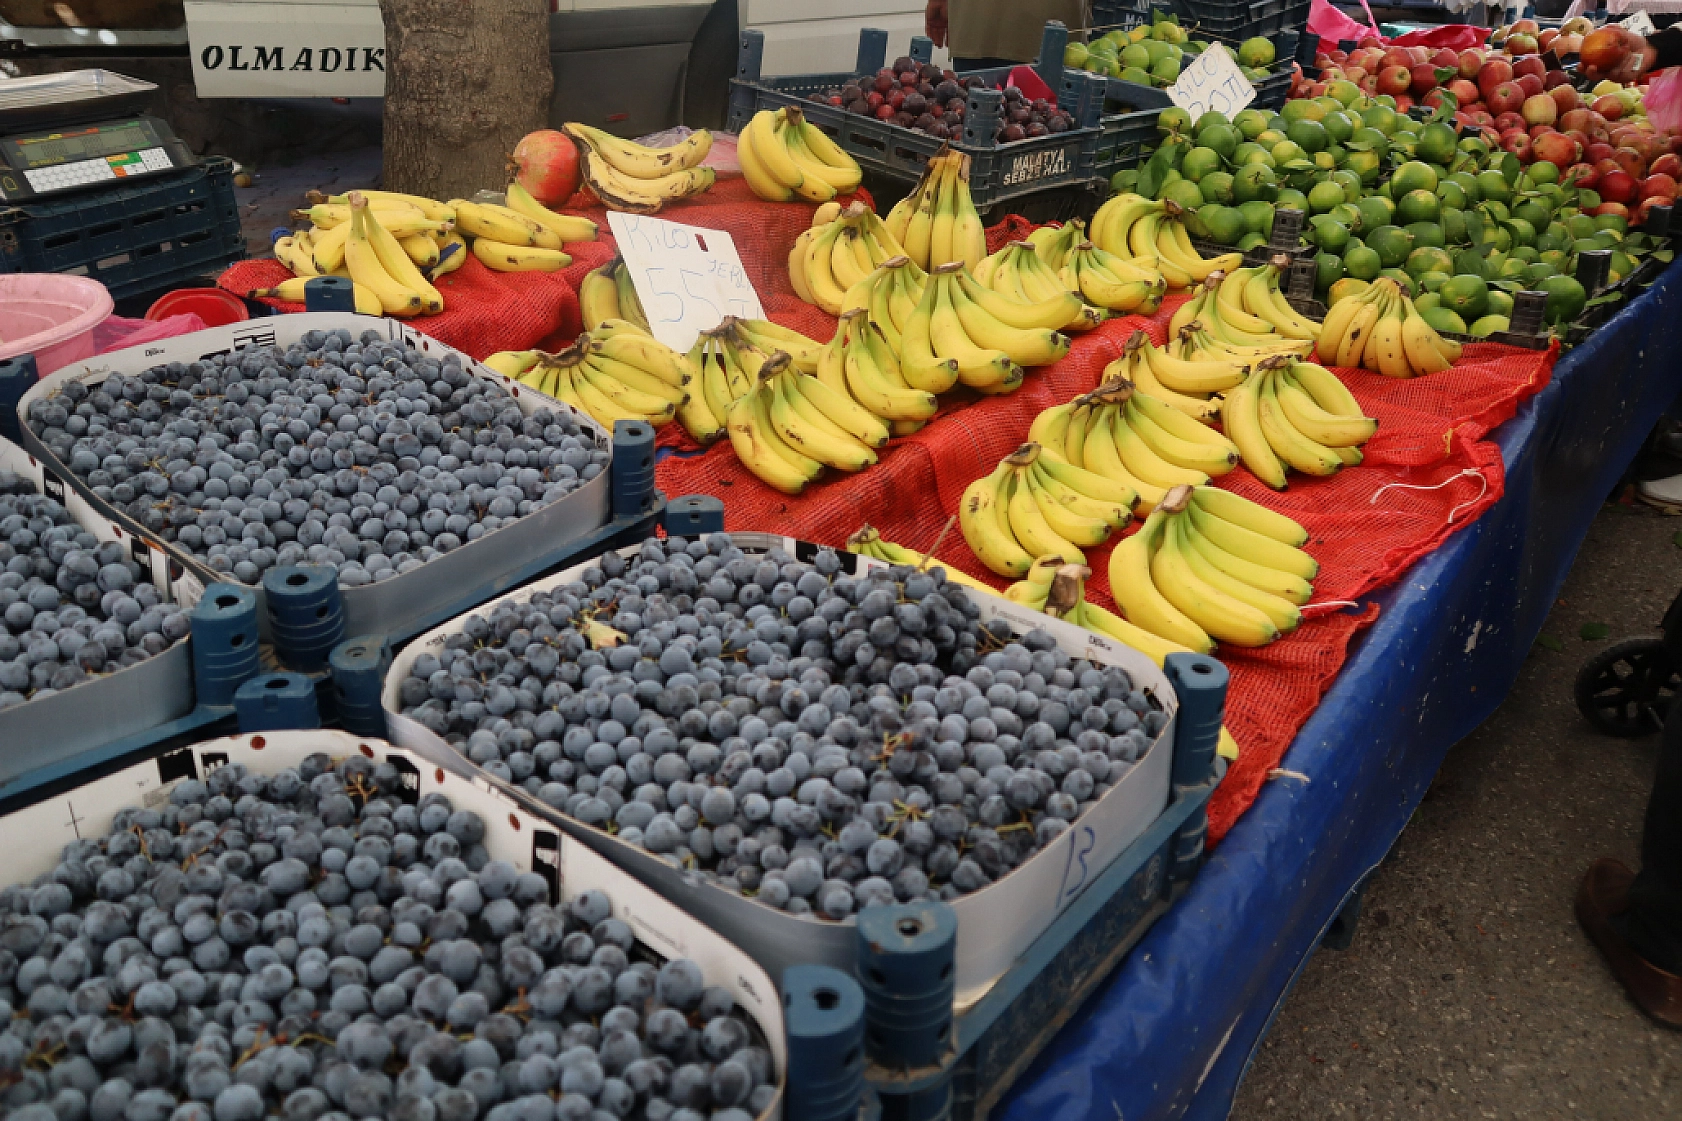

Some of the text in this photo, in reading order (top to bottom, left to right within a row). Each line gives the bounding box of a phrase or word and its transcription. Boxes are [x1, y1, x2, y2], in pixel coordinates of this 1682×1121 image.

[201, 45, 385, 73] OLMADIK
[1012, 148, 1065, 172] MALATYA
[646, 267, 722, 331] 55
